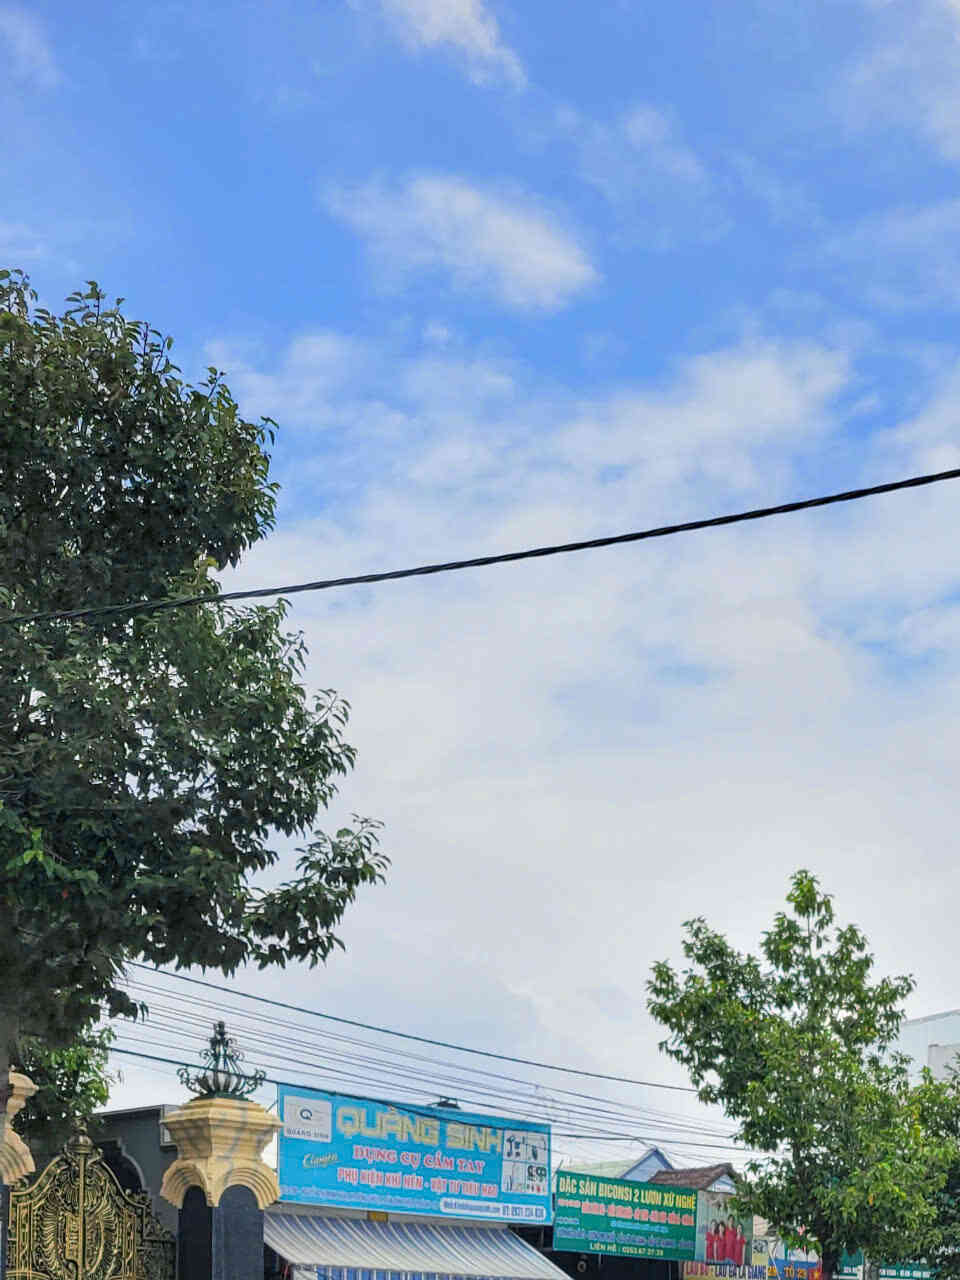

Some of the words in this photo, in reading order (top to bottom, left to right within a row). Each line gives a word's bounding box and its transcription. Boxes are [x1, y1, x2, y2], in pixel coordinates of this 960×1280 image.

[446, 1122, 502, 1153] SINH
[352, 1144, 398, 1165] DỤNG
[400, 1150, 421, 1169] CỤ
[456, 1158, 486, 1175] TAY
[579, 1177, 597, 1197] SẢN
[633, 1189, 640, 1203] 2
